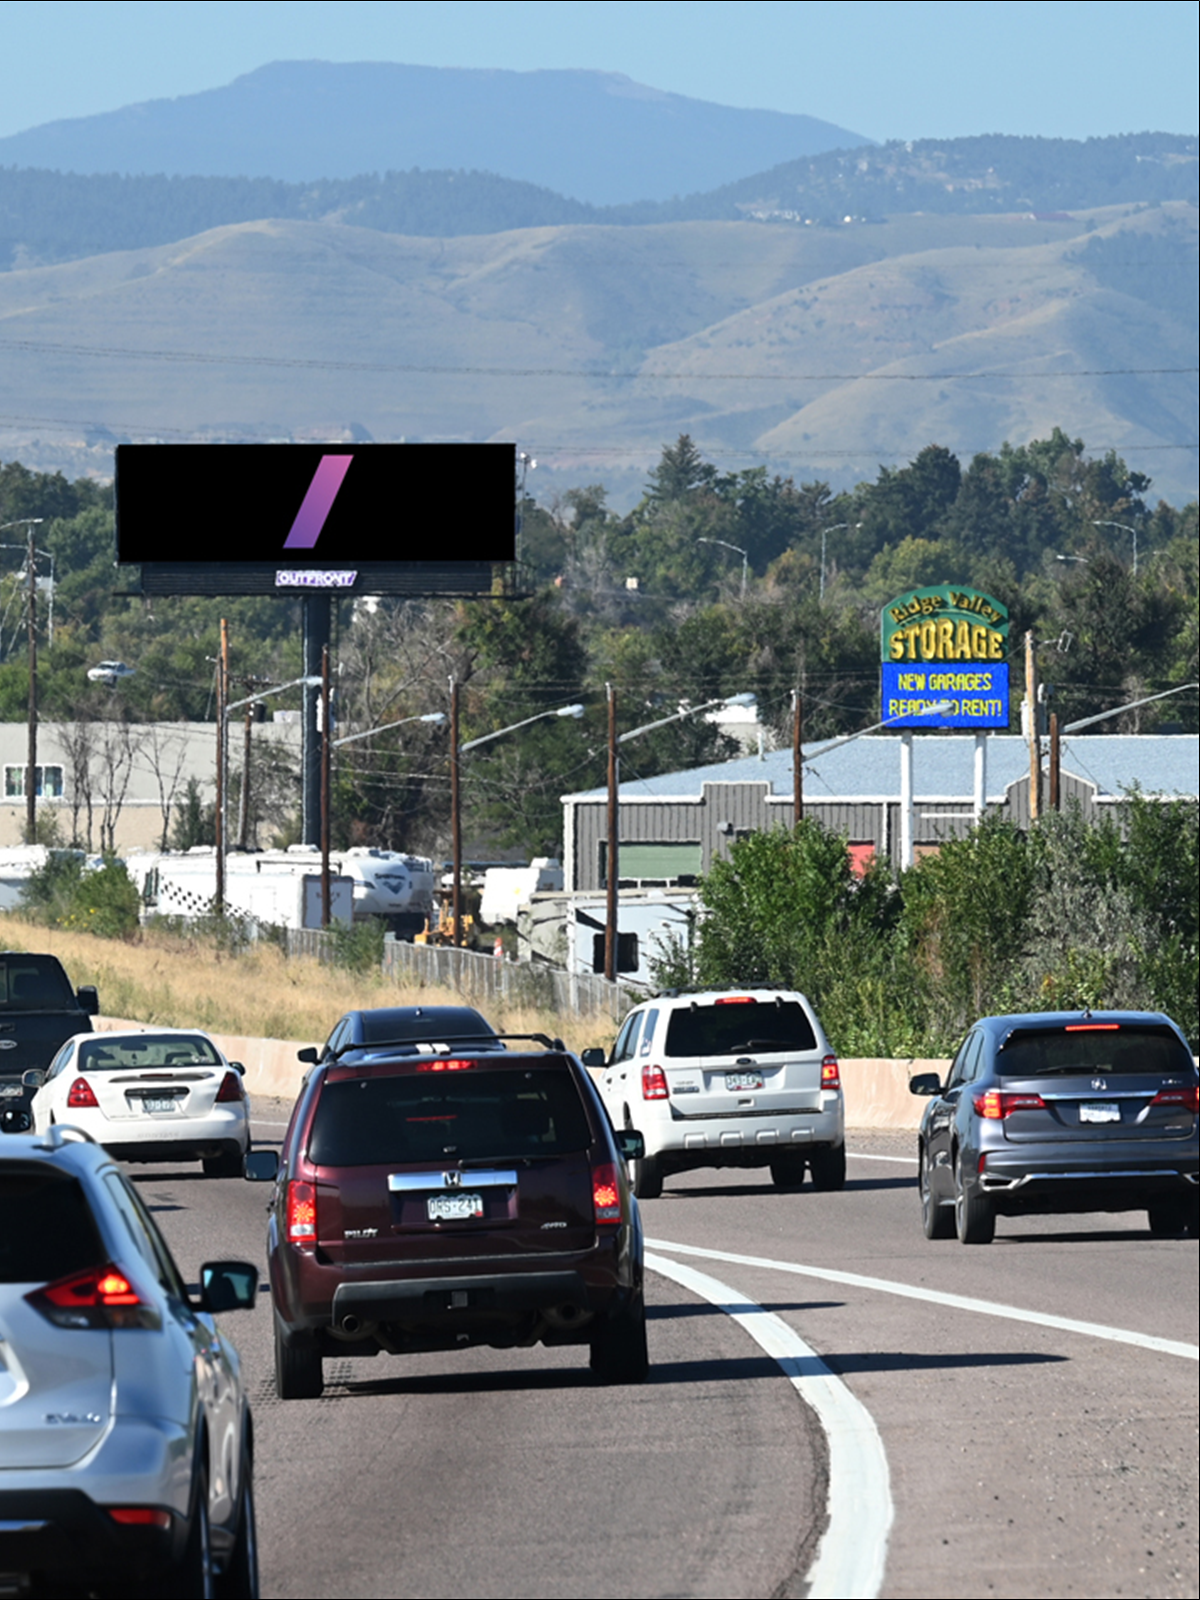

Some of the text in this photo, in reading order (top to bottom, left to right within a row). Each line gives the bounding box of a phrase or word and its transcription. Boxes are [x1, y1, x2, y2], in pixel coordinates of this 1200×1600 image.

[279, 572, 351, 586] OUTFRONT
[888, 591, 1003, 624] Ridge Valley
[889, 617, 1004, 660] STORAGE
[898, 673, 993, 691] NEW GARAGES
[889, 699, 936, 716] READY
[962, 699, 1002, 717] RENT!
[344, 1227, 379, 1239] PILOT
